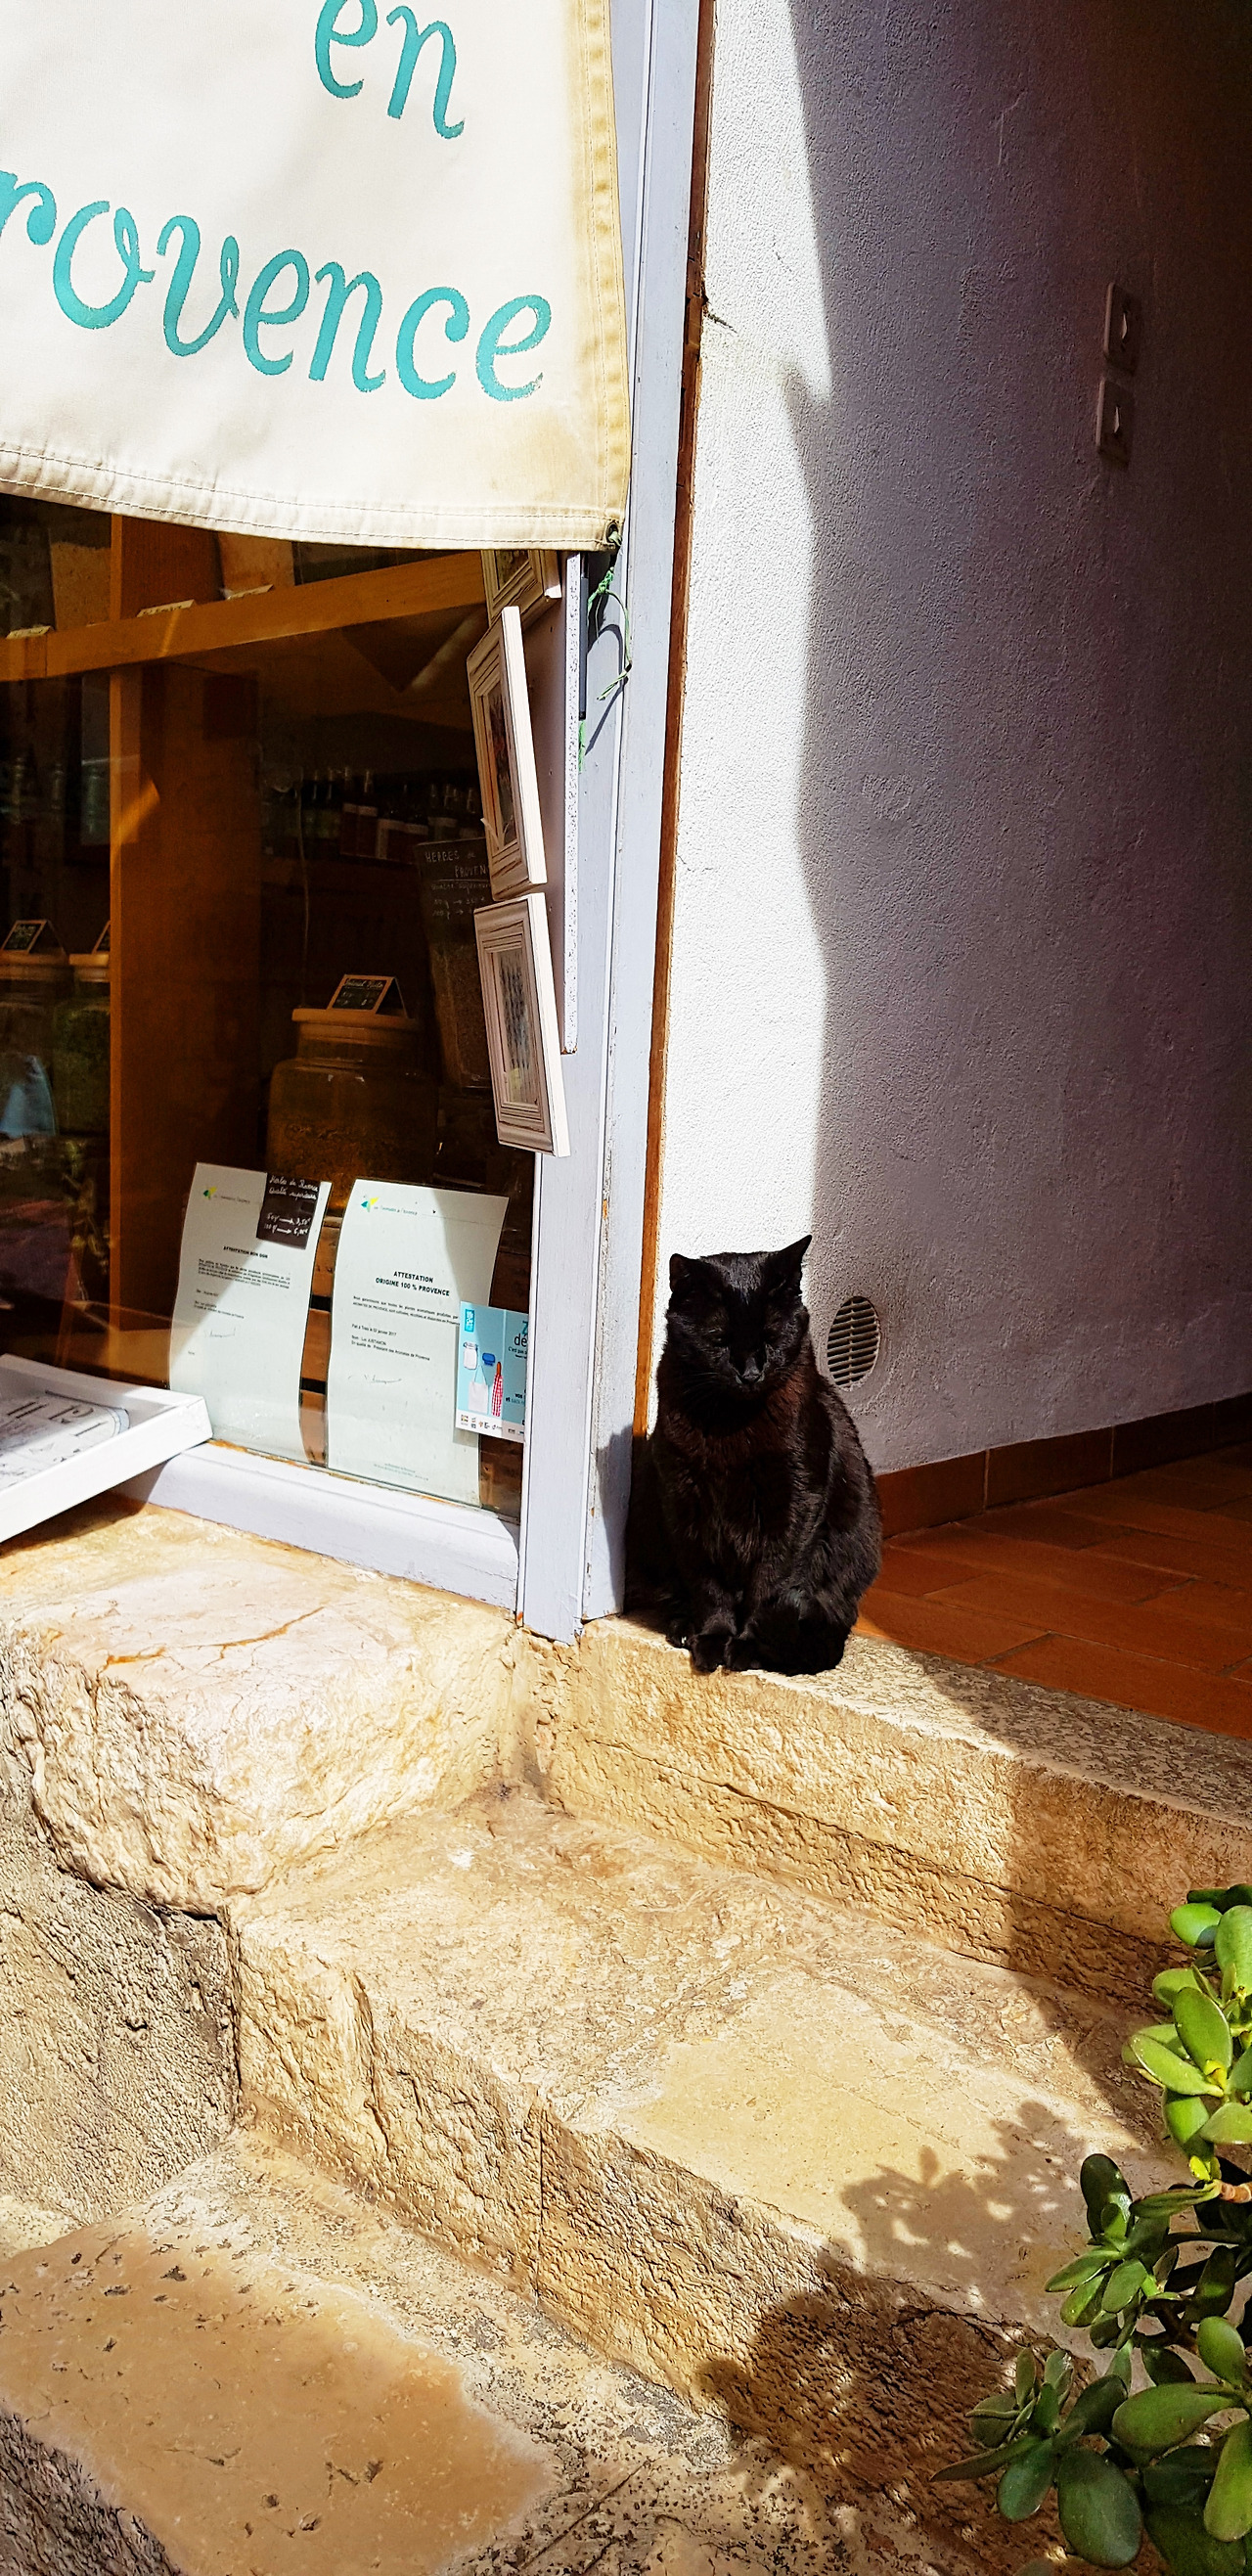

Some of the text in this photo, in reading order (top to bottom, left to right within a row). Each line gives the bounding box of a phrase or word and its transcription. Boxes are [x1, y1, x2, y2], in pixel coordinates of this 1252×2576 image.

[315, 0, 466, 139] en
[455, 864, 489, 879] PROVEN
[393, 1271, 434, 1284] ATTESTATION
[376, 1277, 399, 1288] ORIGINE
[419, 1285, 450, 1296] PROVENCE
